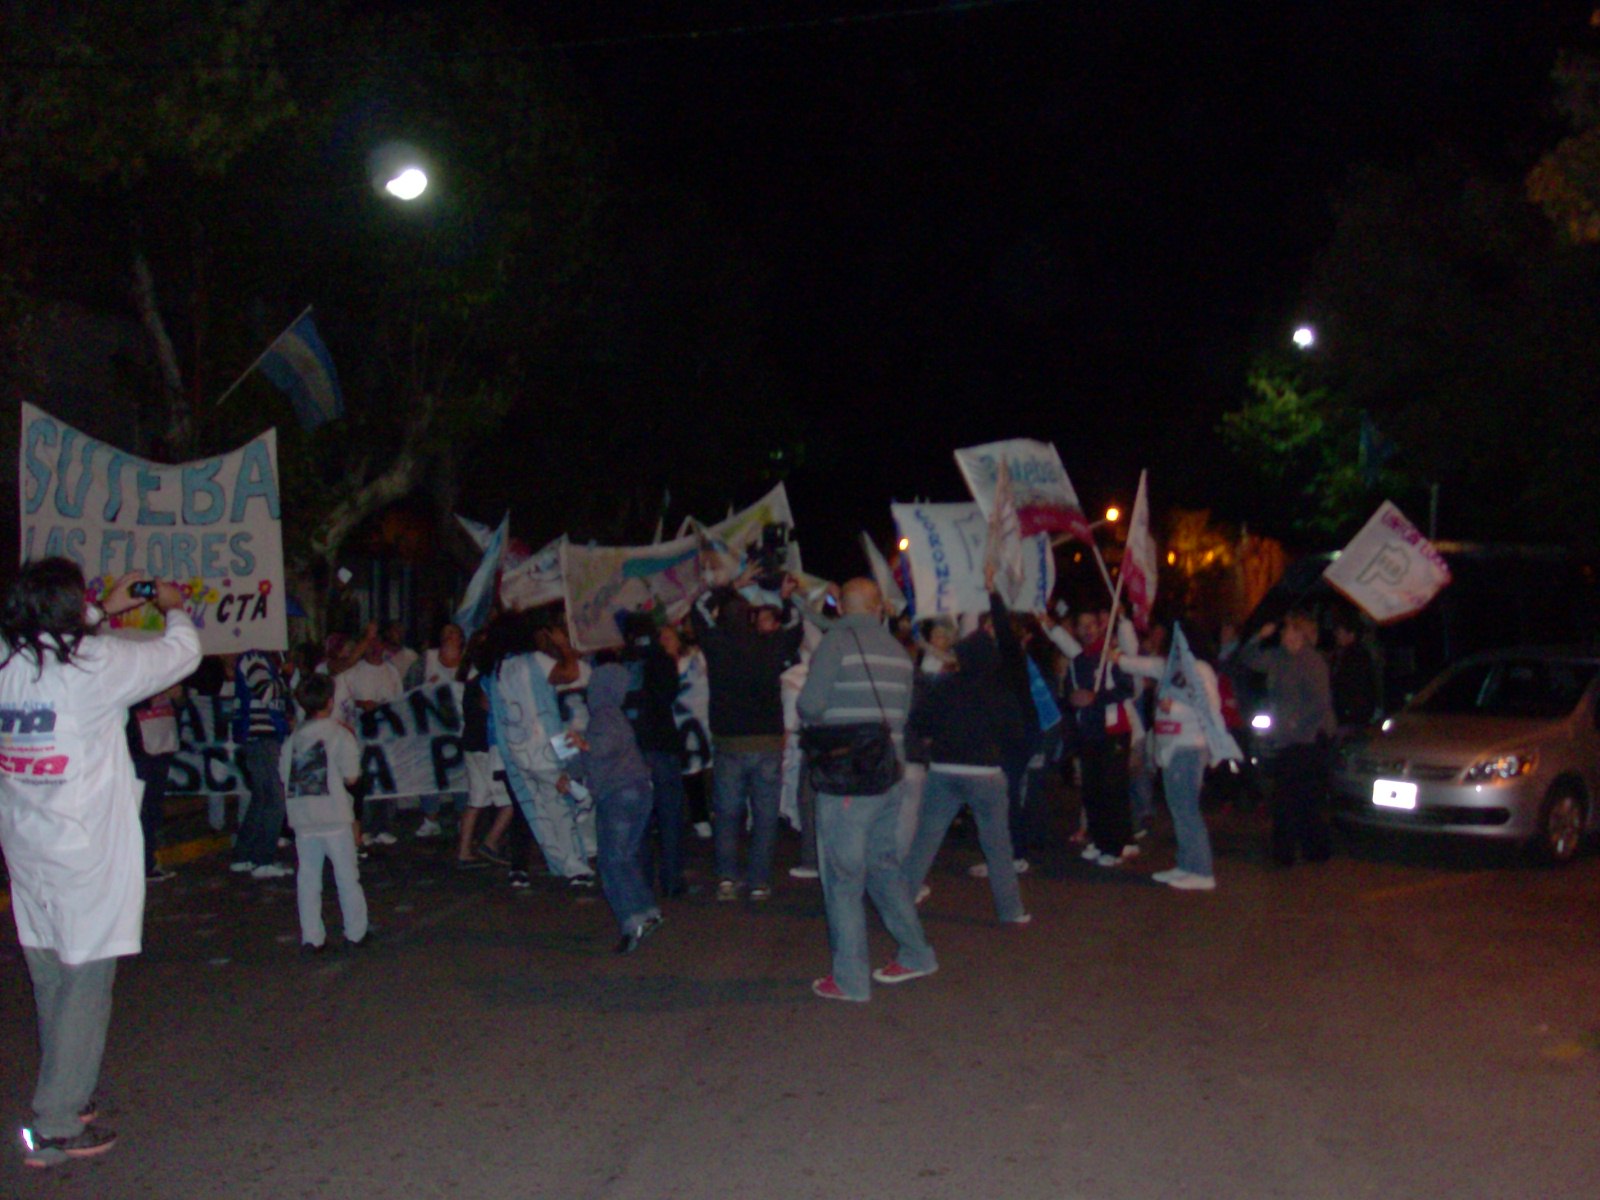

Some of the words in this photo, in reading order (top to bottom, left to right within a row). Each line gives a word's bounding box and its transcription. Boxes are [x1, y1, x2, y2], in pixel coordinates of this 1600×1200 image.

[25, 418, 281, 526] SUTEBA
[101, 528, 257, 579] FLORES
[216, 593, 269, 623] CTA
